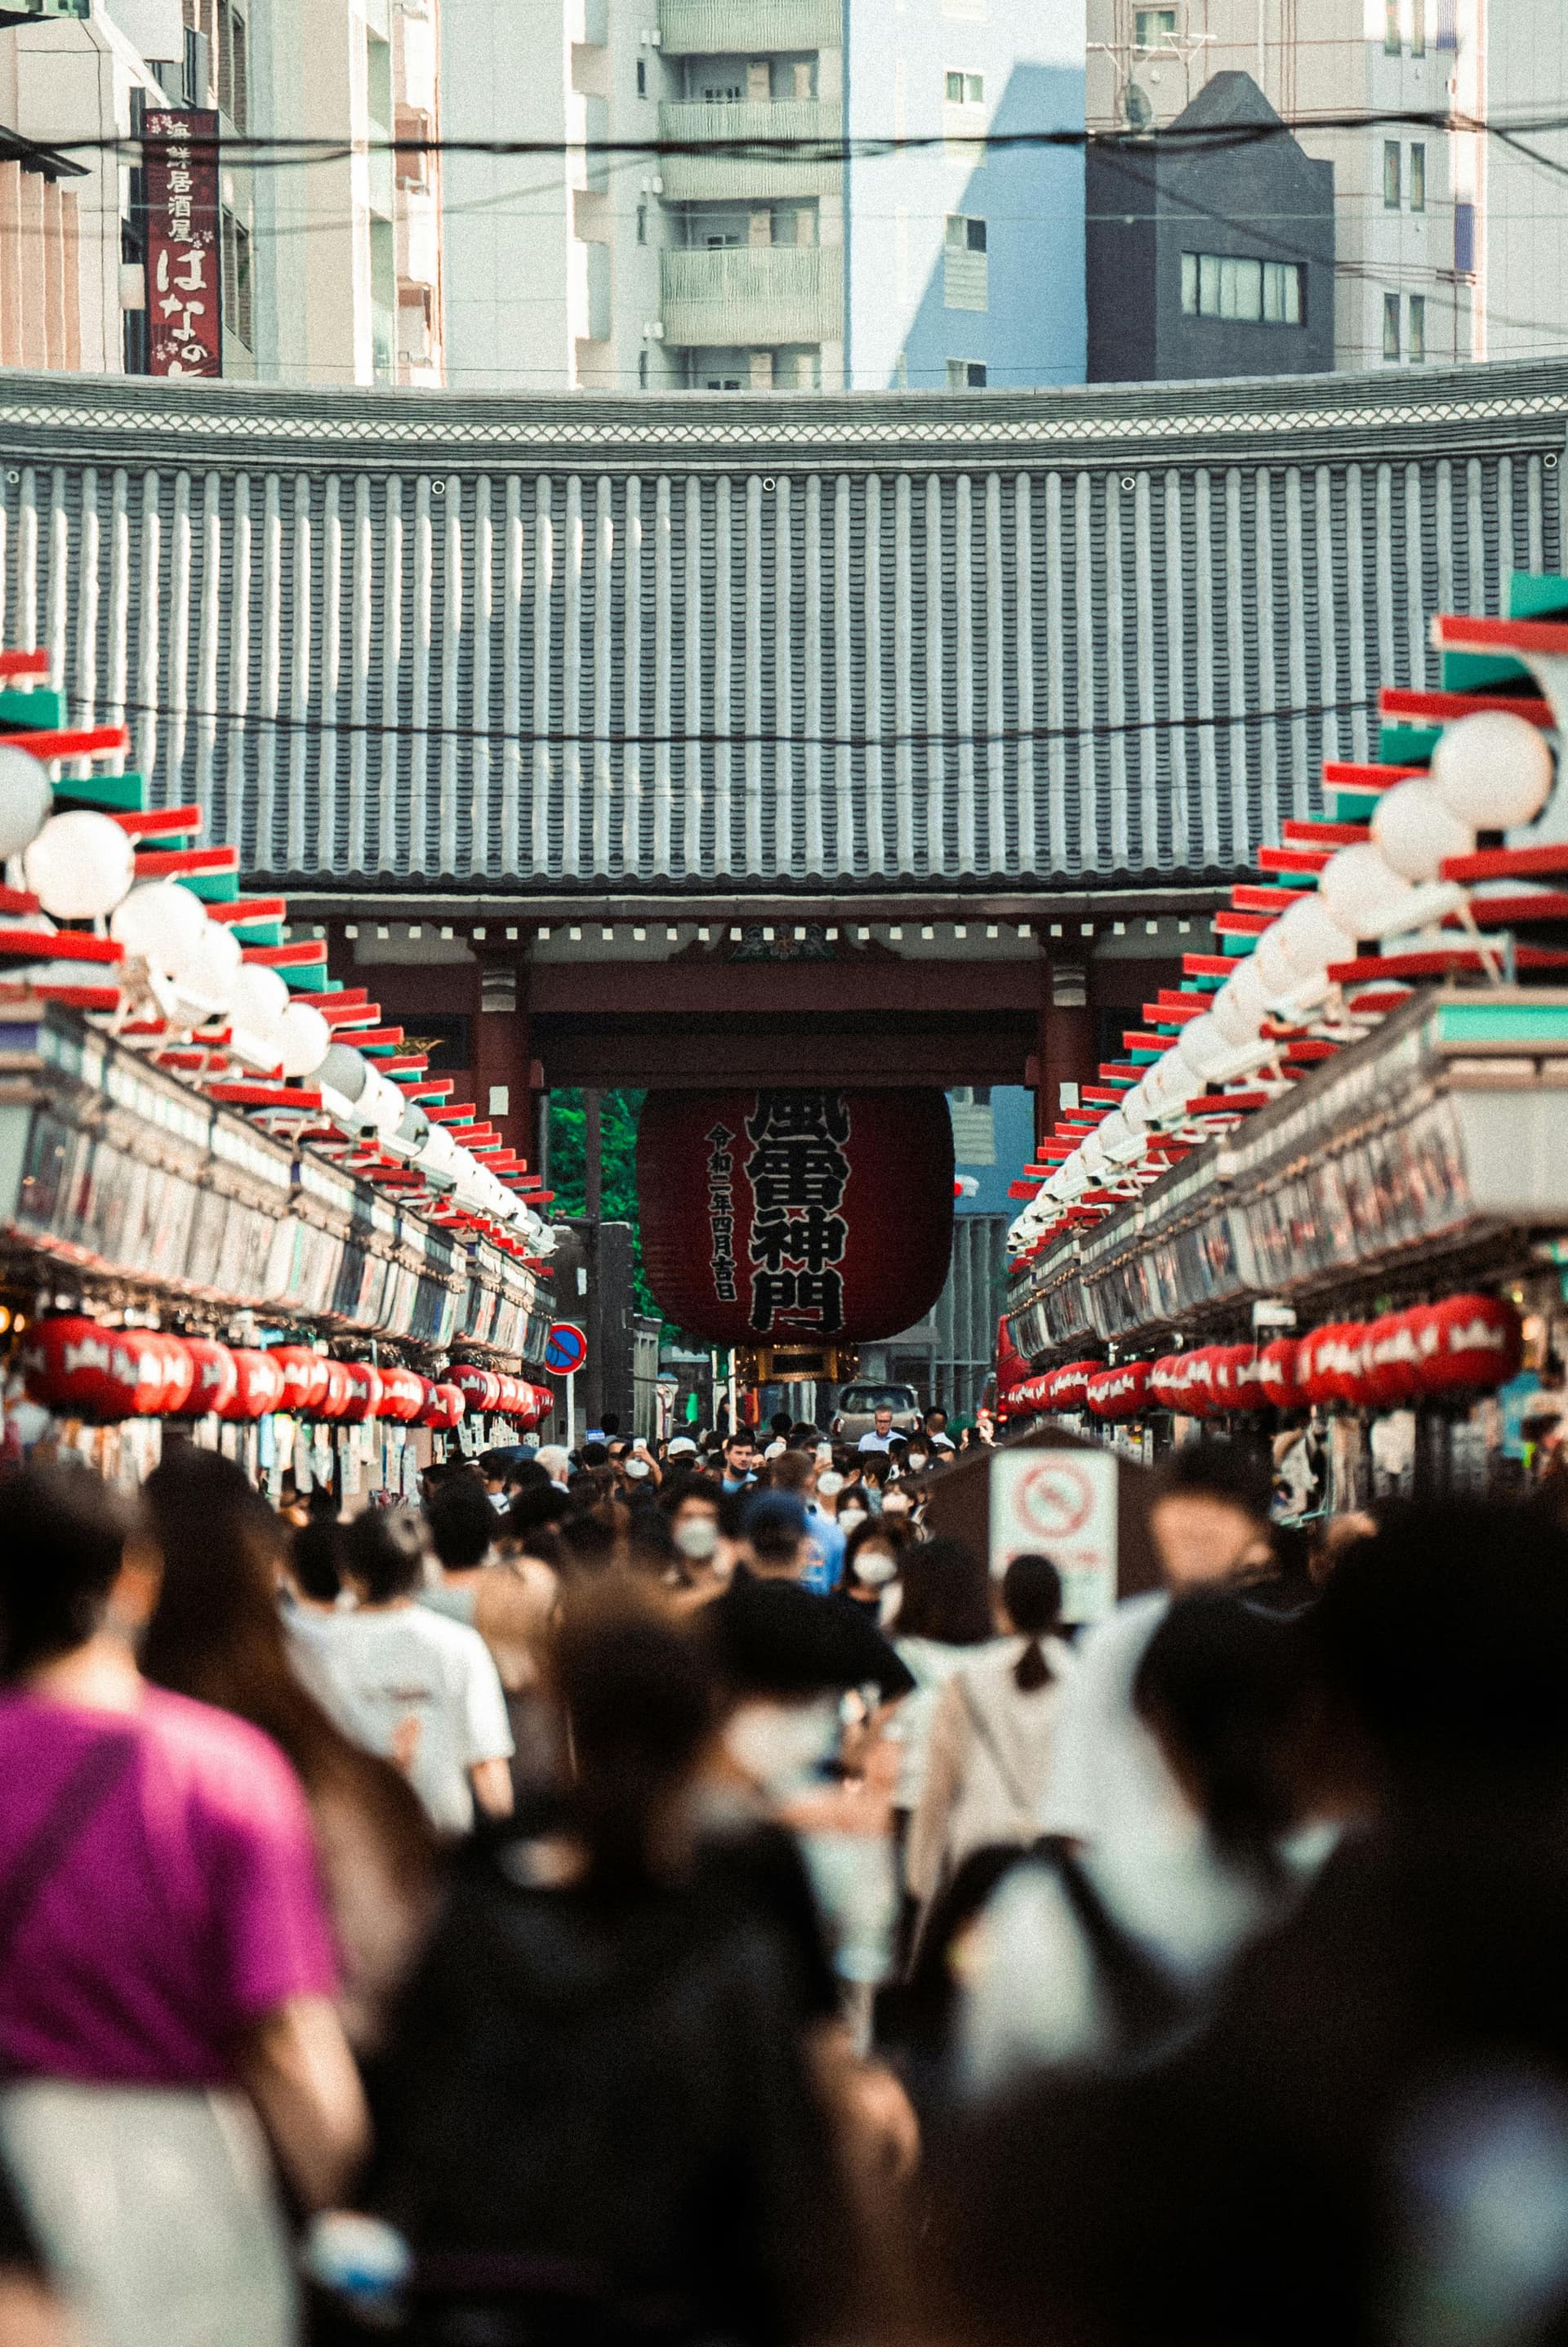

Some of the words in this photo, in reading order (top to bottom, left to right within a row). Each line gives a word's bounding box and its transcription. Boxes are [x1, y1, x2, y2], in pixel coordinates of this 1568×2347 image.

[704, 1121, 737, 1302] 令和二年四月吉日
